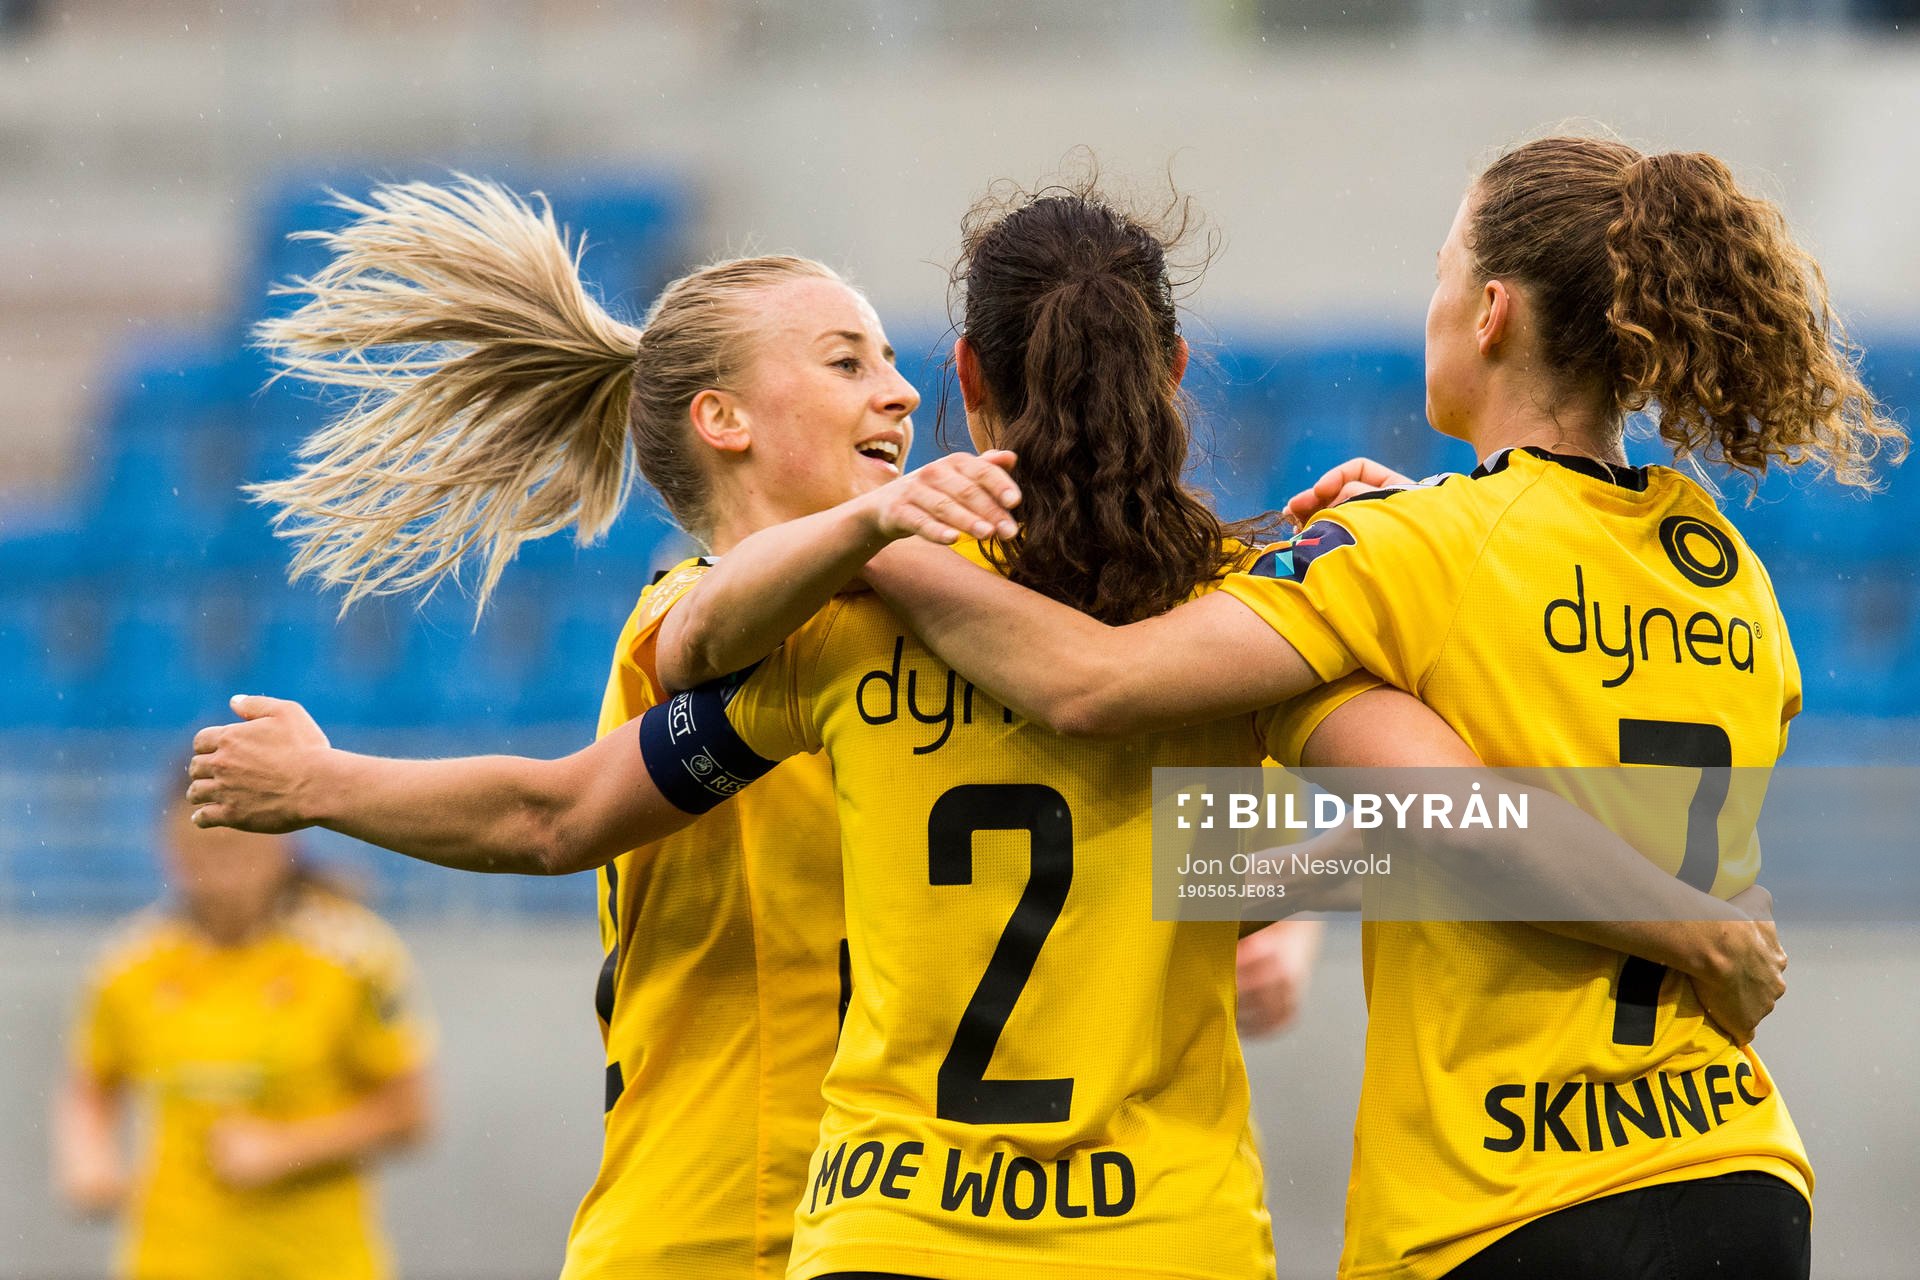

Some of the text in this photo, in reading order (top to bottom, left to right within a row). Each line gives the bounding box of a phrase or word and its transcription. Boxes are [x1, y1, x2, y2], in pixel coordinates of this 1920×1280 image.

[927, 783, 1075, 1125] 2
[1611, 718, 1733, 1047] 7
[809, 1140, 1137, 1221] MOE WOLD
